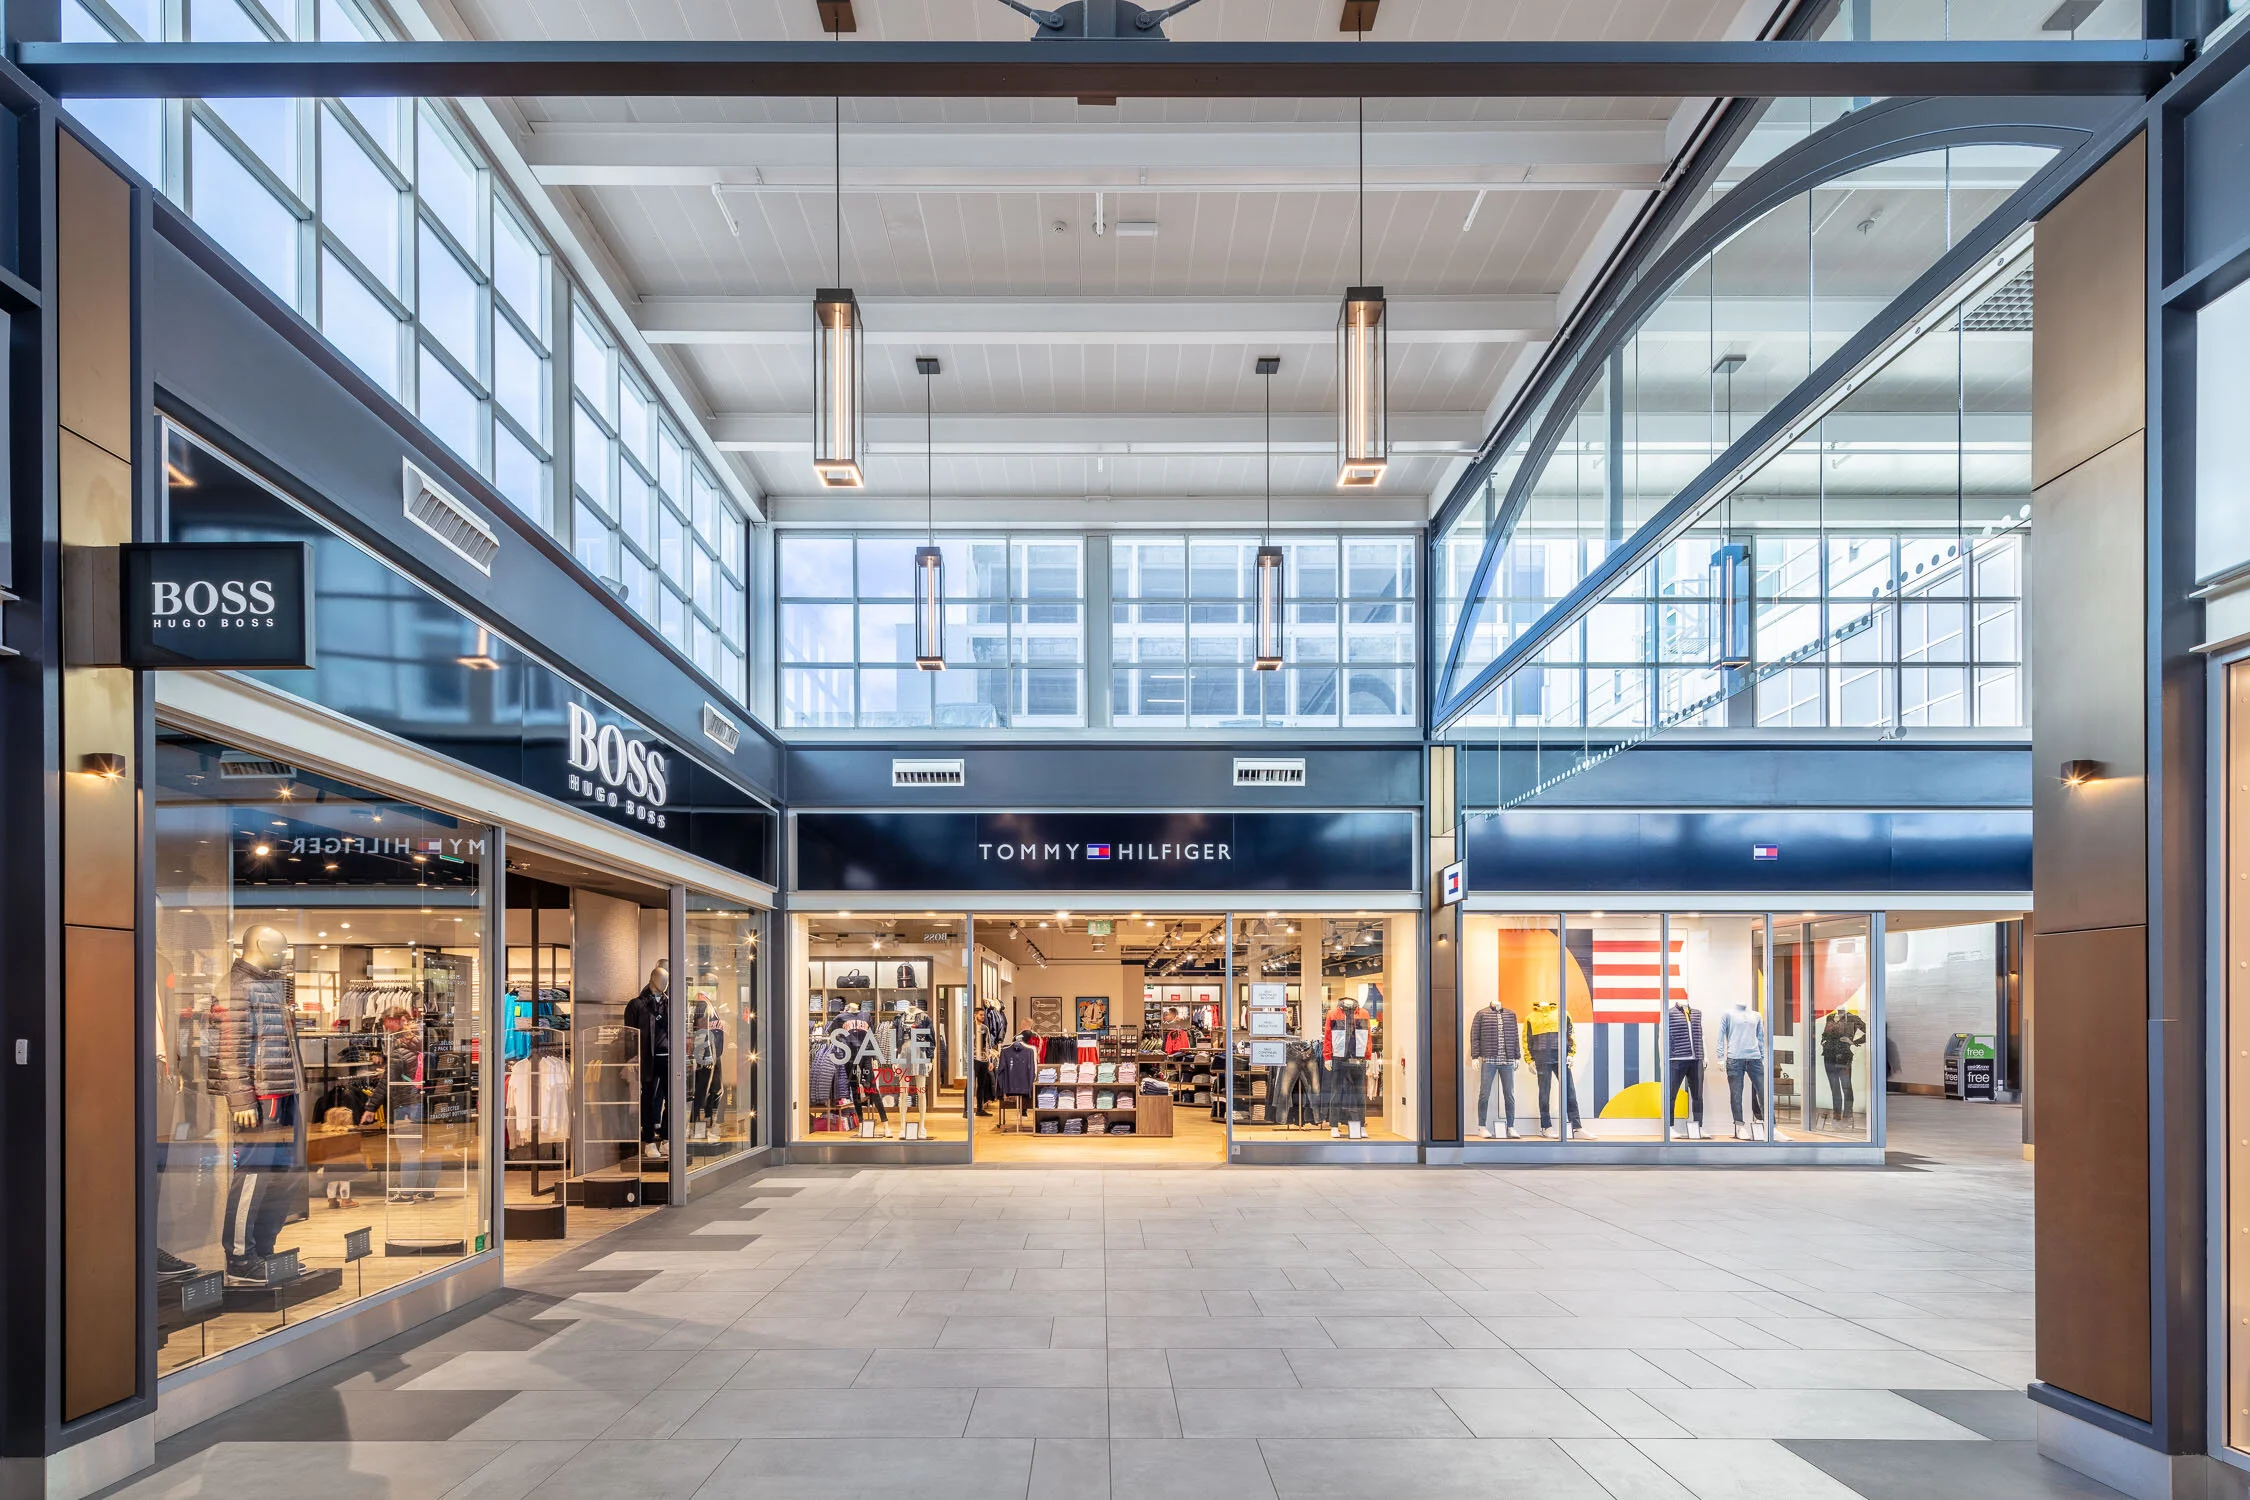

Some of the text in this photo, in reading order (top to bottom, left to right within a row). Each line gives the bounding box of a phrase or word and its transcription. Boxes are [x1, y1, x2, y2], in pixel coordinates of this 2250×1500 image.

[151, 580, 275, 616] BOSS
[153, 618, 274, 628] HUGO BOSS
[567, 701, 667, 807] BOSS
[568, 774, 666, 829] HUGO BOSS
[978, 843, 1232, 861] TOMMY HILFIGER
[828, 1027, 932, 1066] SALE
[1967, 1047, 1985, 1056] free
[872, 1067, 912, 1085] 70%
[1967, 1071, 1990, 1083] free
[857, 1086, 927, 1095] FINAL REDUCTIONS
